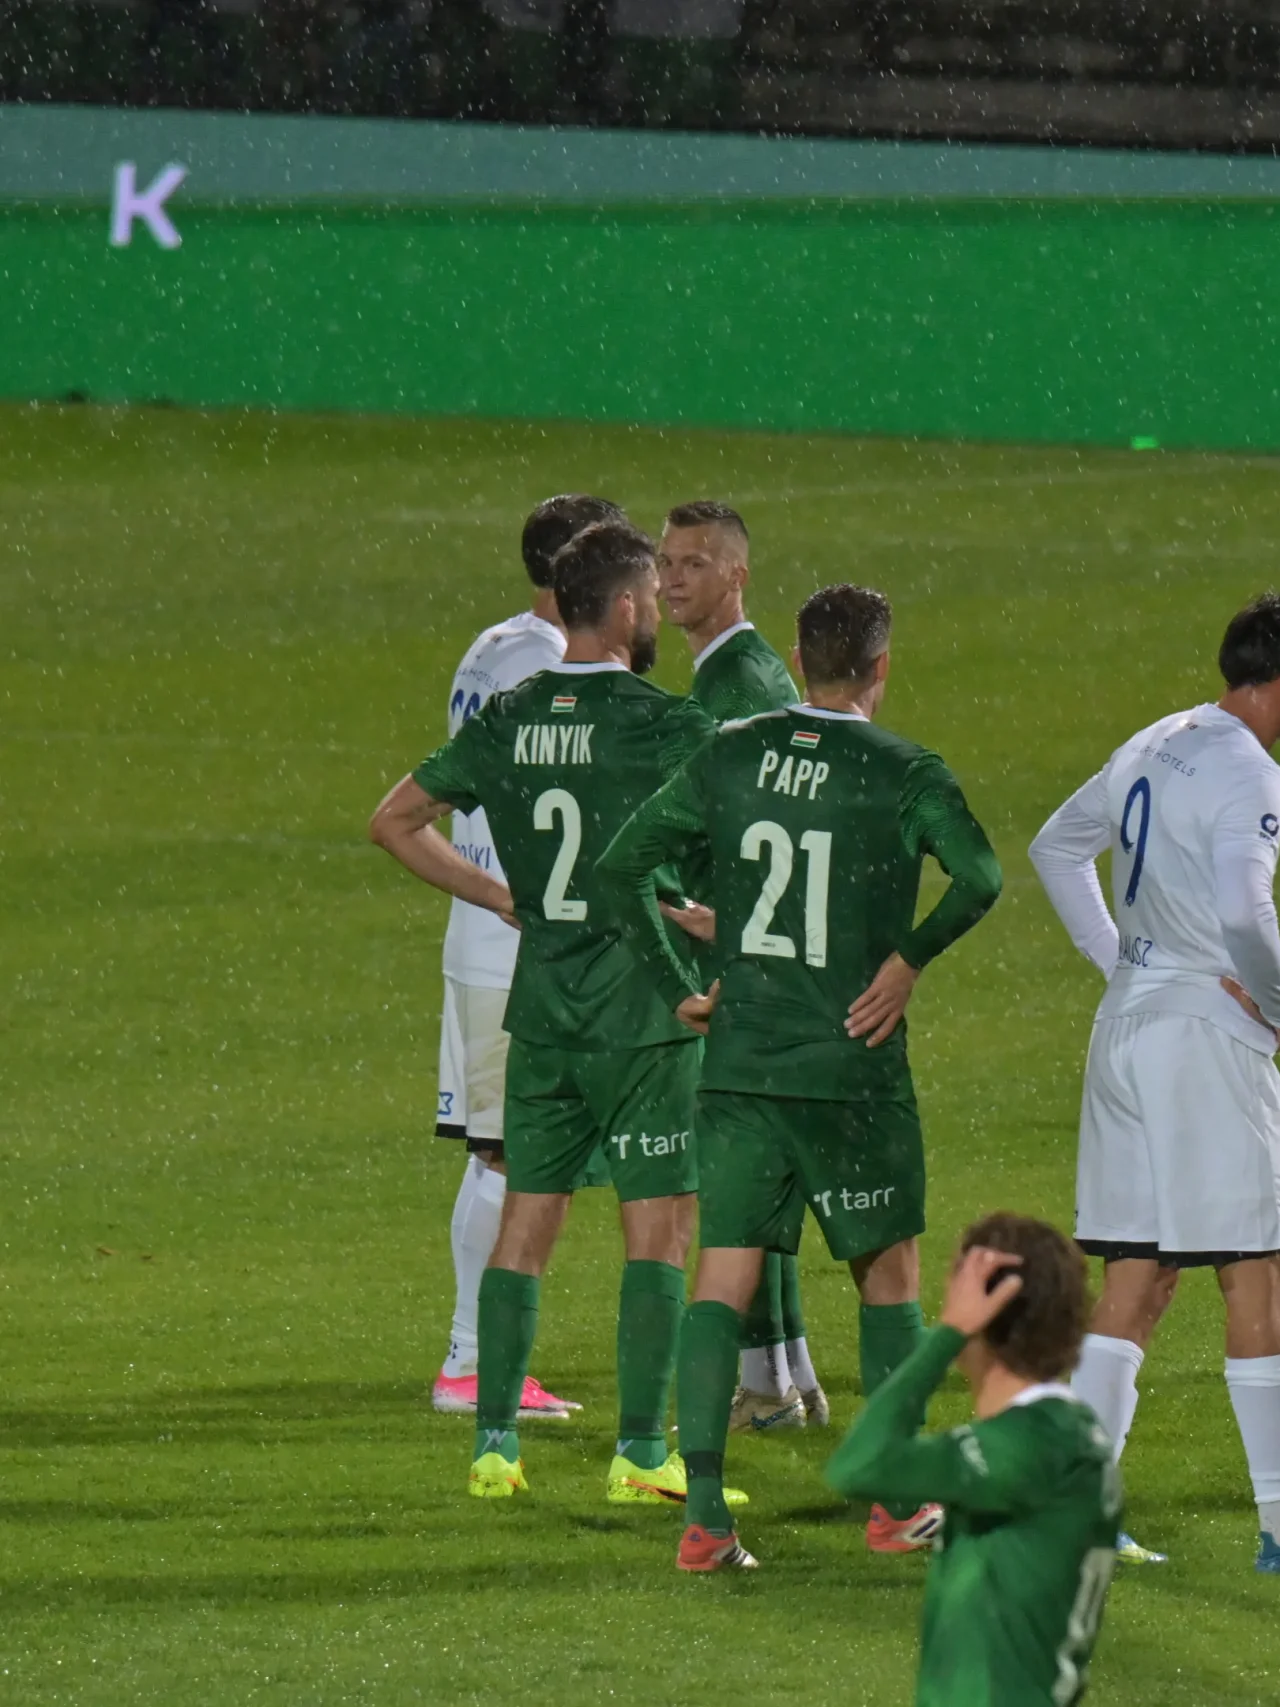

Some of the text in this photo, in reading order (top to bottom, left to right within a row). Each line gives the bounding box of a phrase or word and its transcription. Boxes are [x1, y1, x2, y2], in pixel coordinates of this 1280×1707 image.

[110, 161, 188, 248] K
[514, 724, 595, 764] KINYIK
[757, 749, 829, 800] PAPP
[533, 788, 588, 921] 2
[1120, 776, 1151, 907] 9
[740, 820, 832, 968] 21
[639, 1131, 690, 1157] tarr
[839, 1187, 895, 1211] tarr
